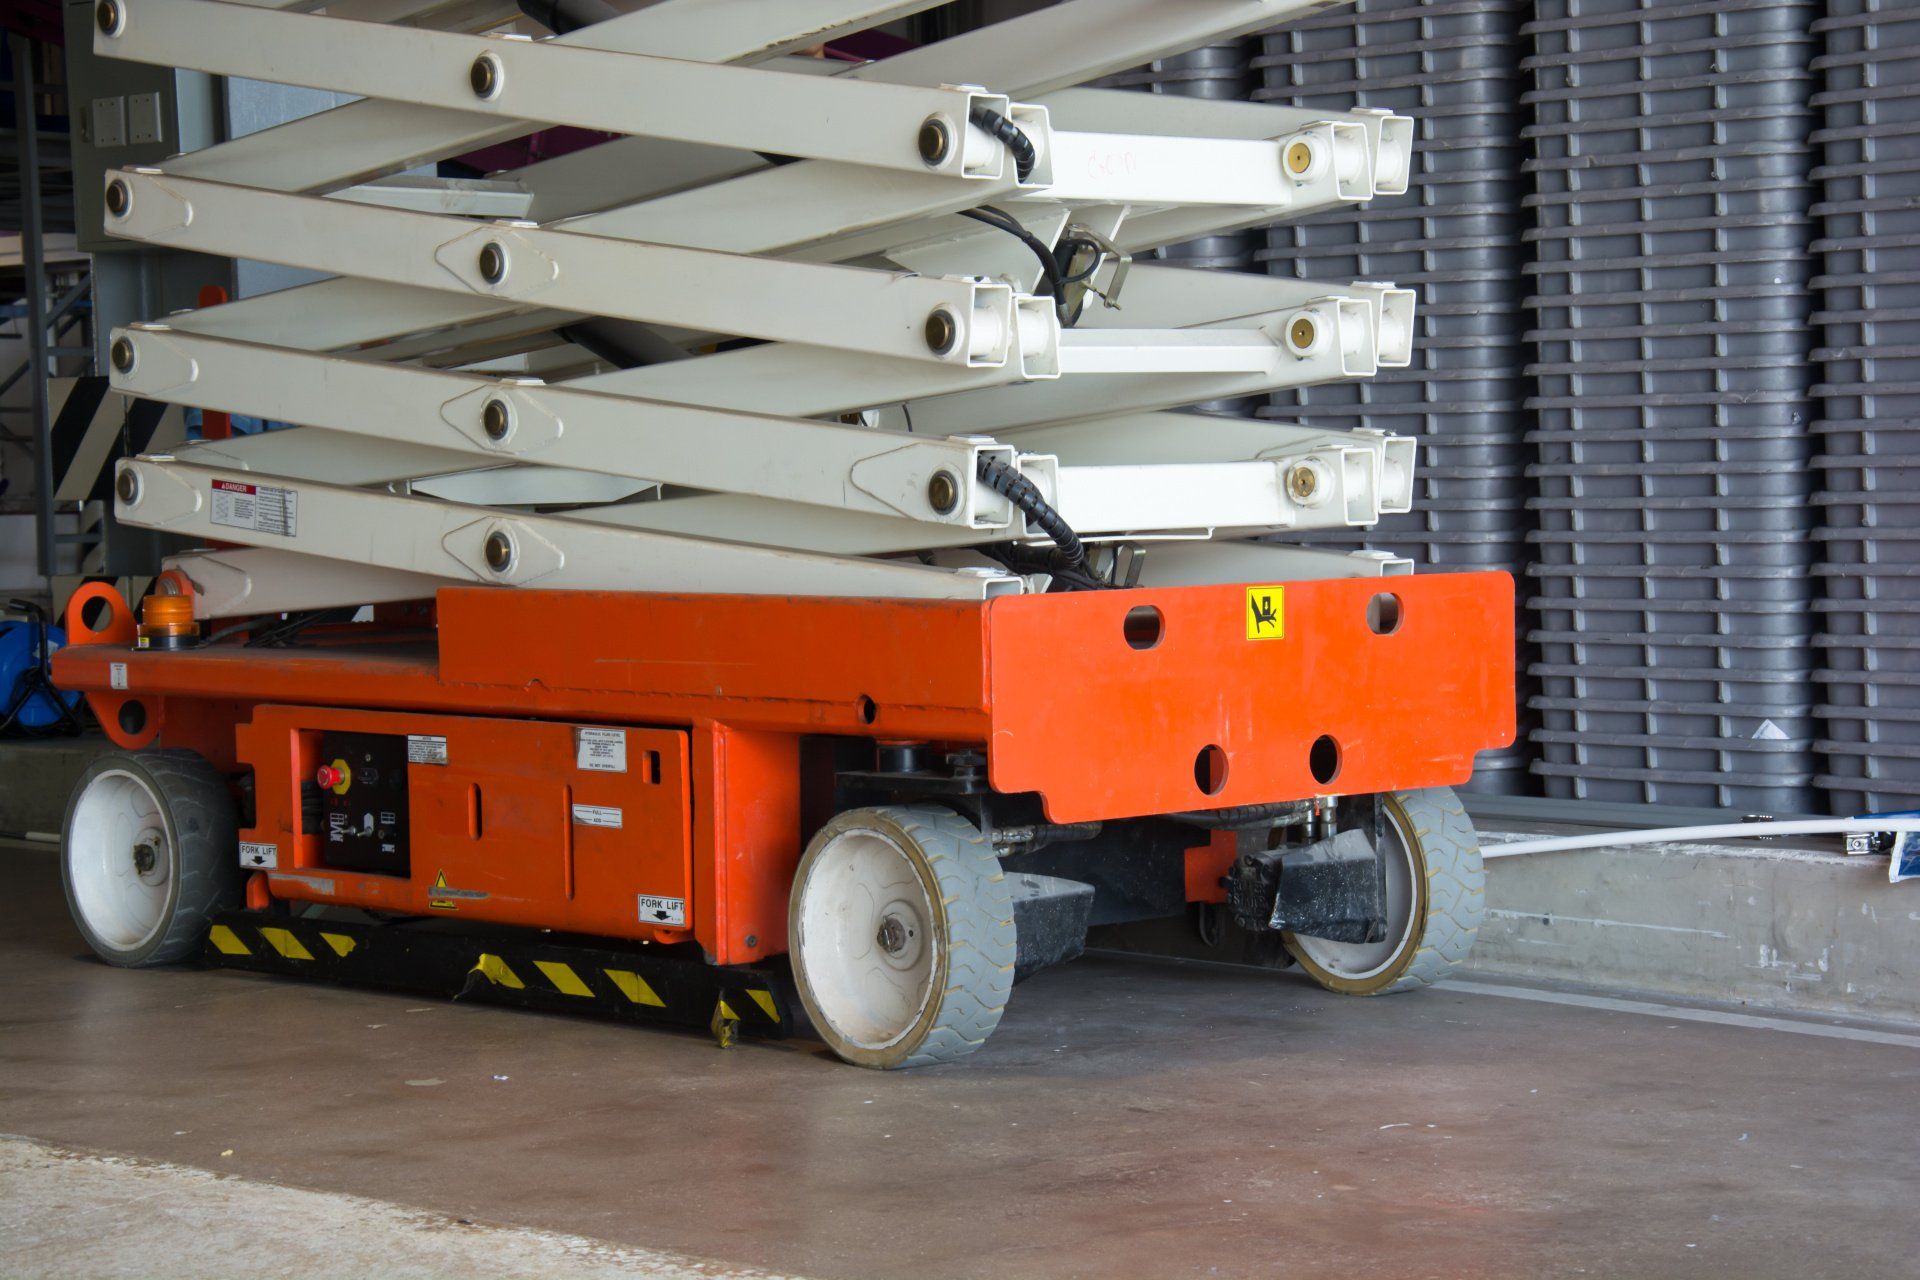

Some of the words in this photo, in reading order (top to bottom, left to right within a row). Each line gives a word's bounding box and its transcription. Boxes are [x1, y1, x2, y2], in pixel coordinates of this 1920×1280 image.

[225, 483, 247, 492] DANGER
[241, 846, 259, 854] FORK
[262, 847, 276, 855] LIFT
[641, 898, 663, 908] FORK
[666, 901, 684, 910] LIFT
